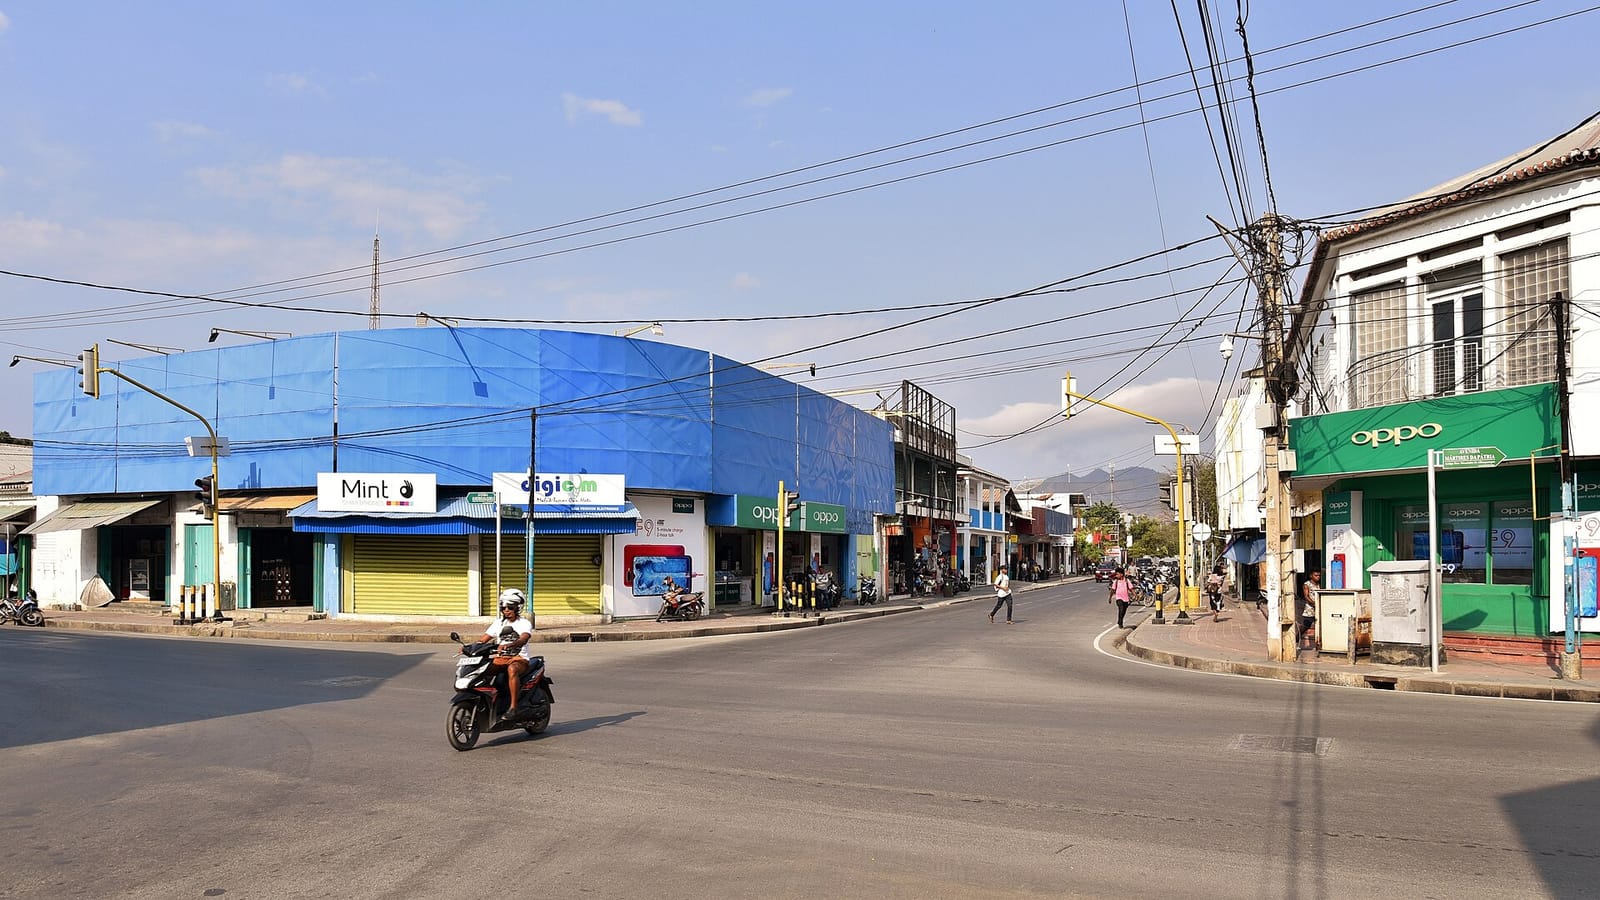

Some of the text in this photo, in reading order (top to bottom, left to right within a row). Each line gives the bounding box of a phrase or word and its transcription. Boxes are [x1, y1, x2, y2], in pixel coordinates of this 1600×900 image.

[1351, 423, 1442, 447] oppo
[342, 479, 389, 498] Mint
[1329, 501, 1348, 510] oppo
[1449, 508, 1480, 517] oppo
[752, 505, 779, 524] opp
[813, 511, 839, 525] oppo
